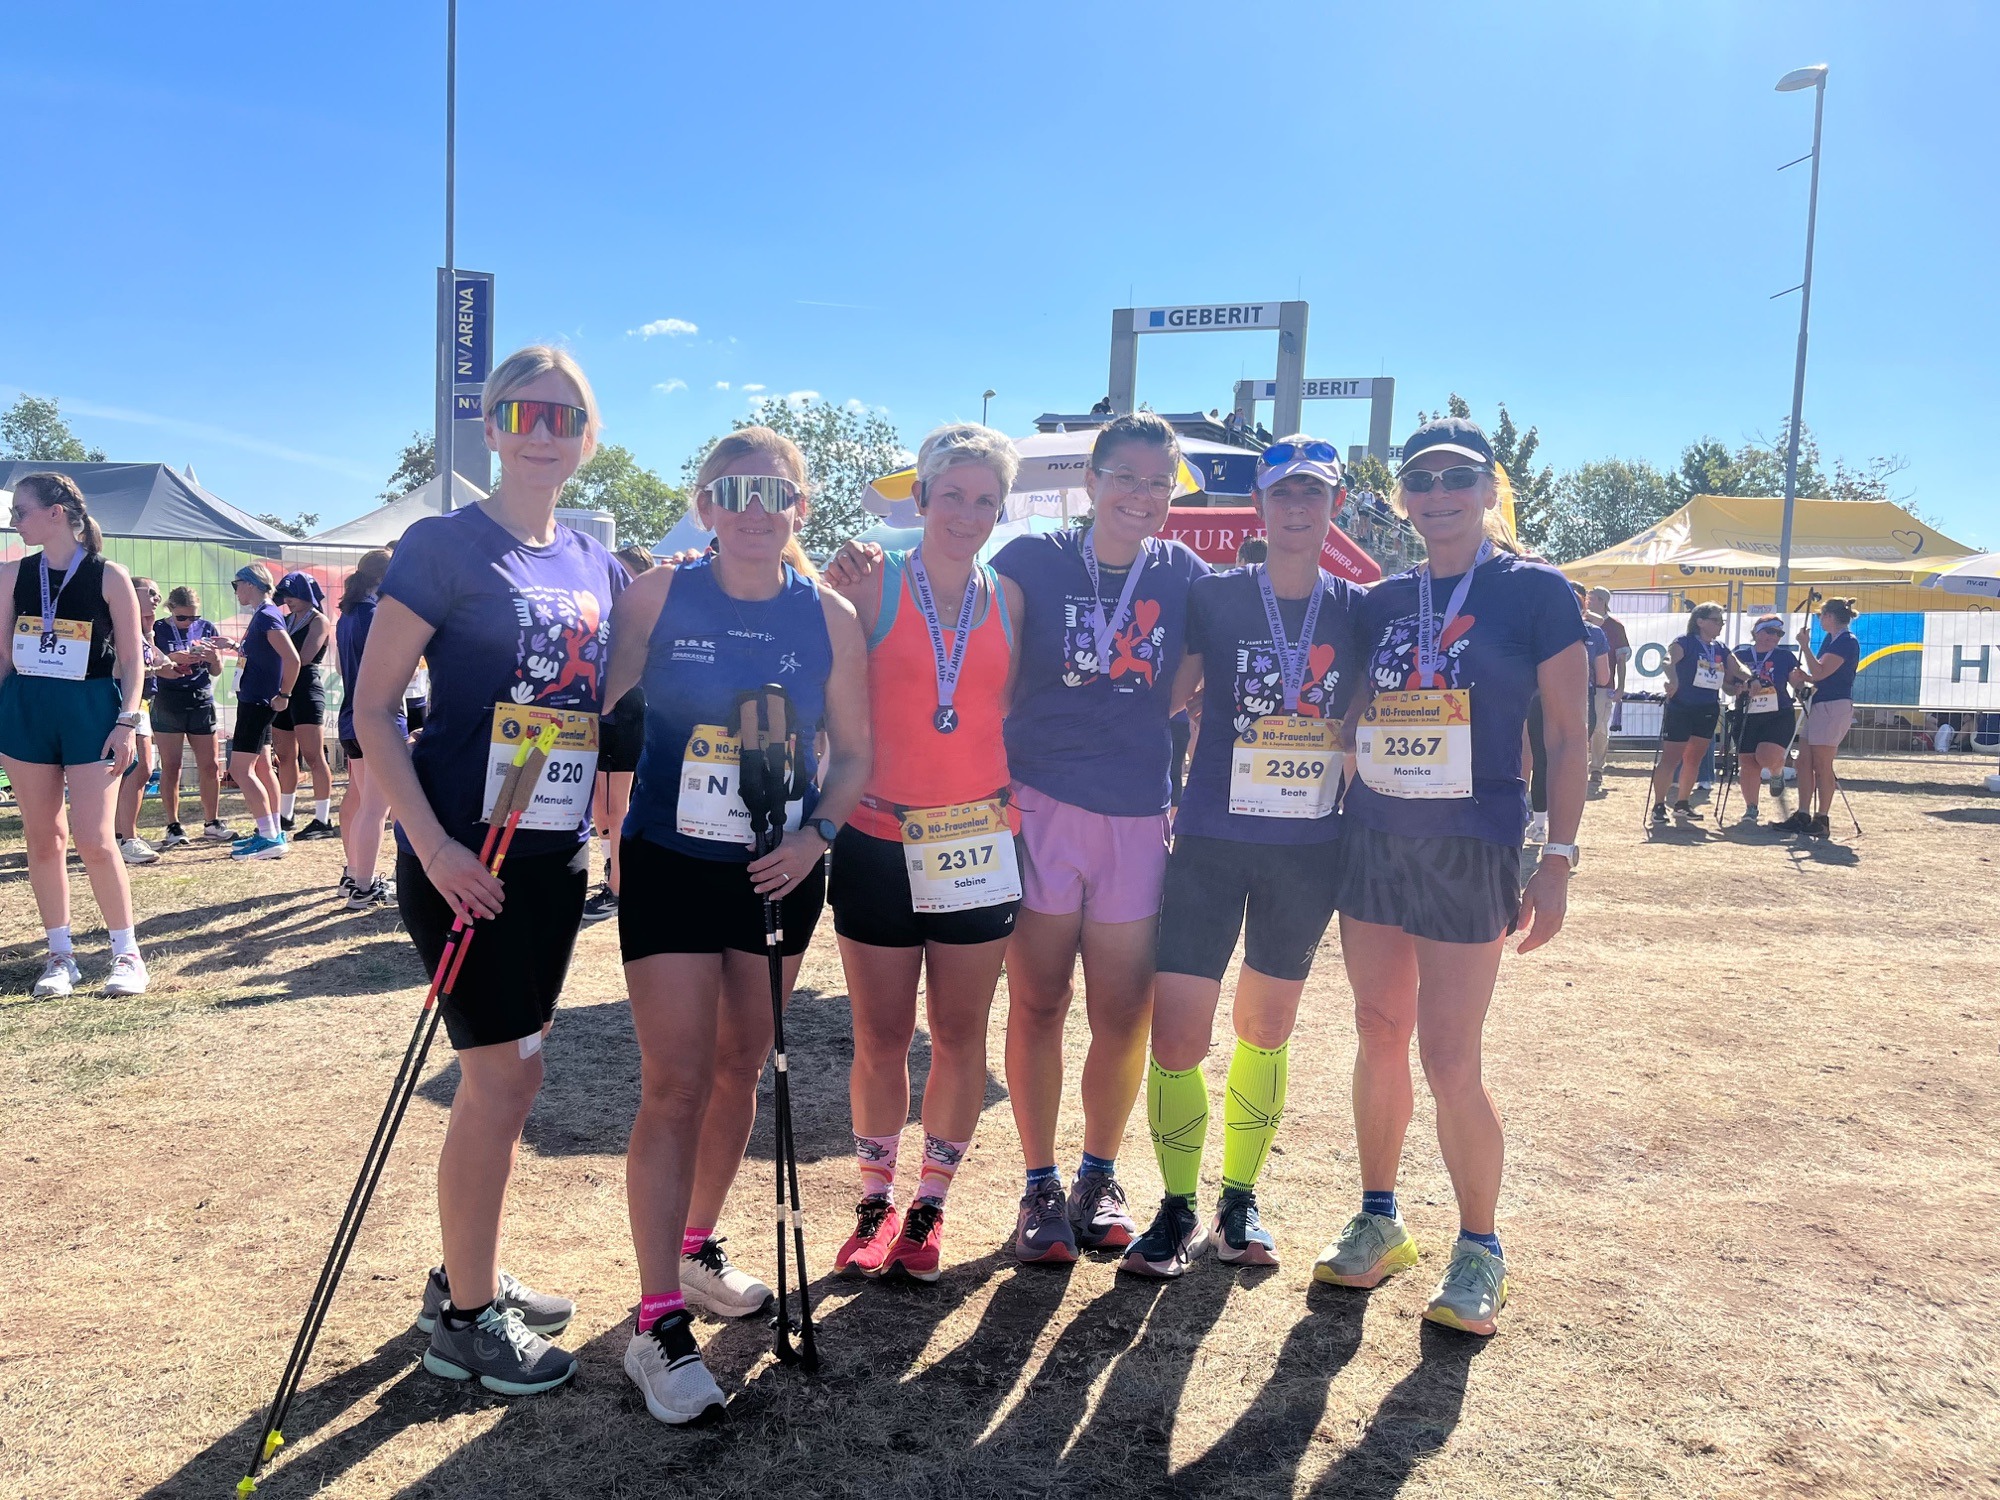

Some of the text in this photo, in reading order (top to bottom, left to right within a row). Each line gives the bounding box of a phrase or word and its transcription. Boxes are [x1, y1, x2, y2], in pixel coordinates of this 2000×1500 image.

[1168, 306, 1264, 327] GEBERIT
[458, 287, 474, 375] NV ARENA
[1302, 381, 1359, 396] EBERIT
[916, 571, 926, 582] 20
[1966, 578, 1988, 588] nv.at
[919, 584, 933, 610] JAHRE
[1262, 585, 1272, 596] 20
[1265, 597, 1279, 622] JAHRE
[727, 630, 765, 640] CRAFT
[39, 643, 67, 656] 813
[1421, 630, 1430, 655] JAHRE
[672, 652, 708, 661] SPARKASSE
[946, 672, 956, 684] 20
[951, 643, 964, 671] JAHRE
[1421, 656, 1429, 665] 20
[1291, 679, 1299, 690] 20
[1296, 653, 1307, 678] JAHRE
[1380, 704, 1441, 717] NÖ-Frauenlauf
[1262, 729, 1325, 742] NÖ-Frauenlauf
[1384, 737, 1442, 757] 2367
[547, 761, 584, 784] 820
[1266, 759, 1325, 779] 2369
[1393, 767, 1432, 776] Monika
[707, 775, 729, 796] N
[1281, 788, 1308, 797] Beate
[533, 794, 574, 805] Manuela
[728, 808, 751, 819] Mon
[927, 815, 989, 834] NÖ-Frauenlauf
[937, 845, 994, 872] 2317
[954, 877, 987, 889] Sabine
